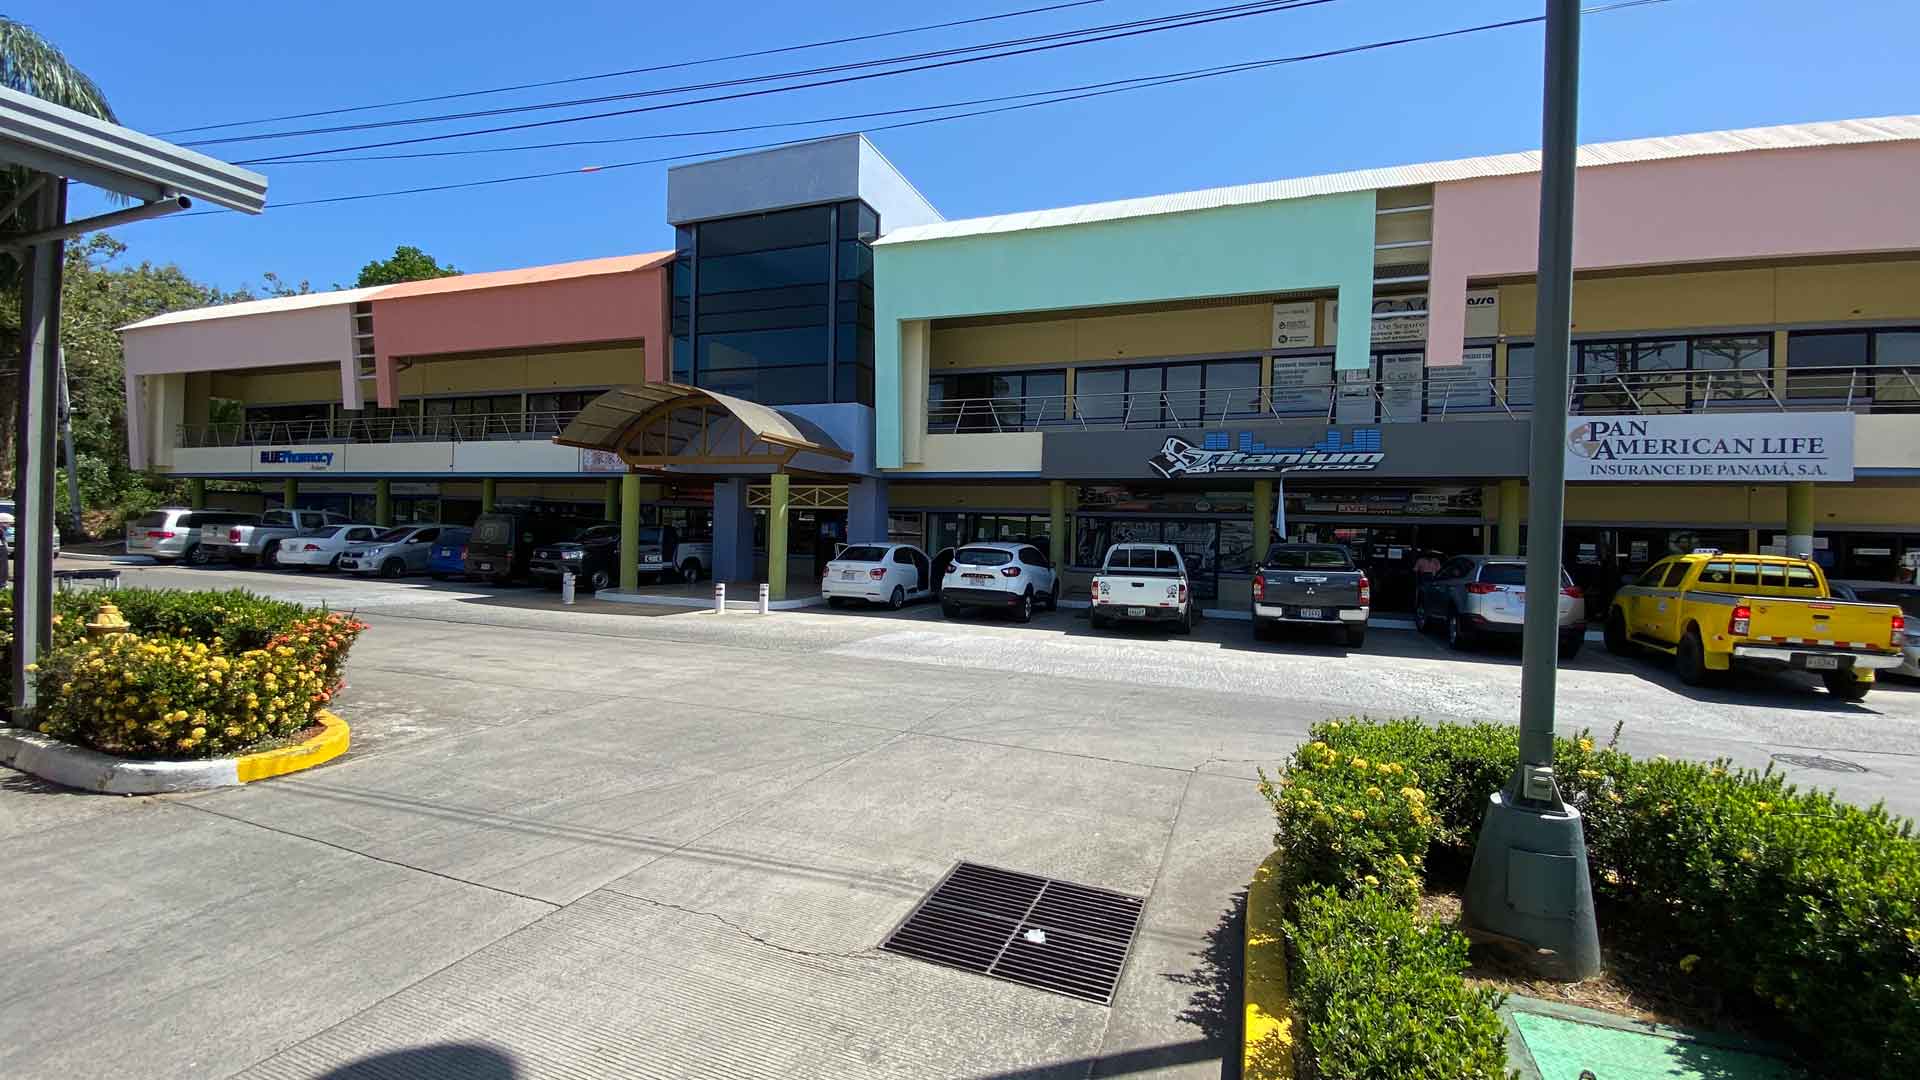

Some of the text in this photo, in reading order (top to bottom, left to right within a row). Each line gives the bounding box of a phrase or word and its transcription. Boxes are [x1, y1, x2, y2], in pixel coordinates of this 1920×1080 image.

[1588, 420, 1648, 442] PAN
[1192, 450, 1385, 465] Titanium
[1592, 437, 1824, 460] AMERICAN LIFE
[1590, 461, 1828, 477] INSURANCE DE PANAMÁ, S.A.
